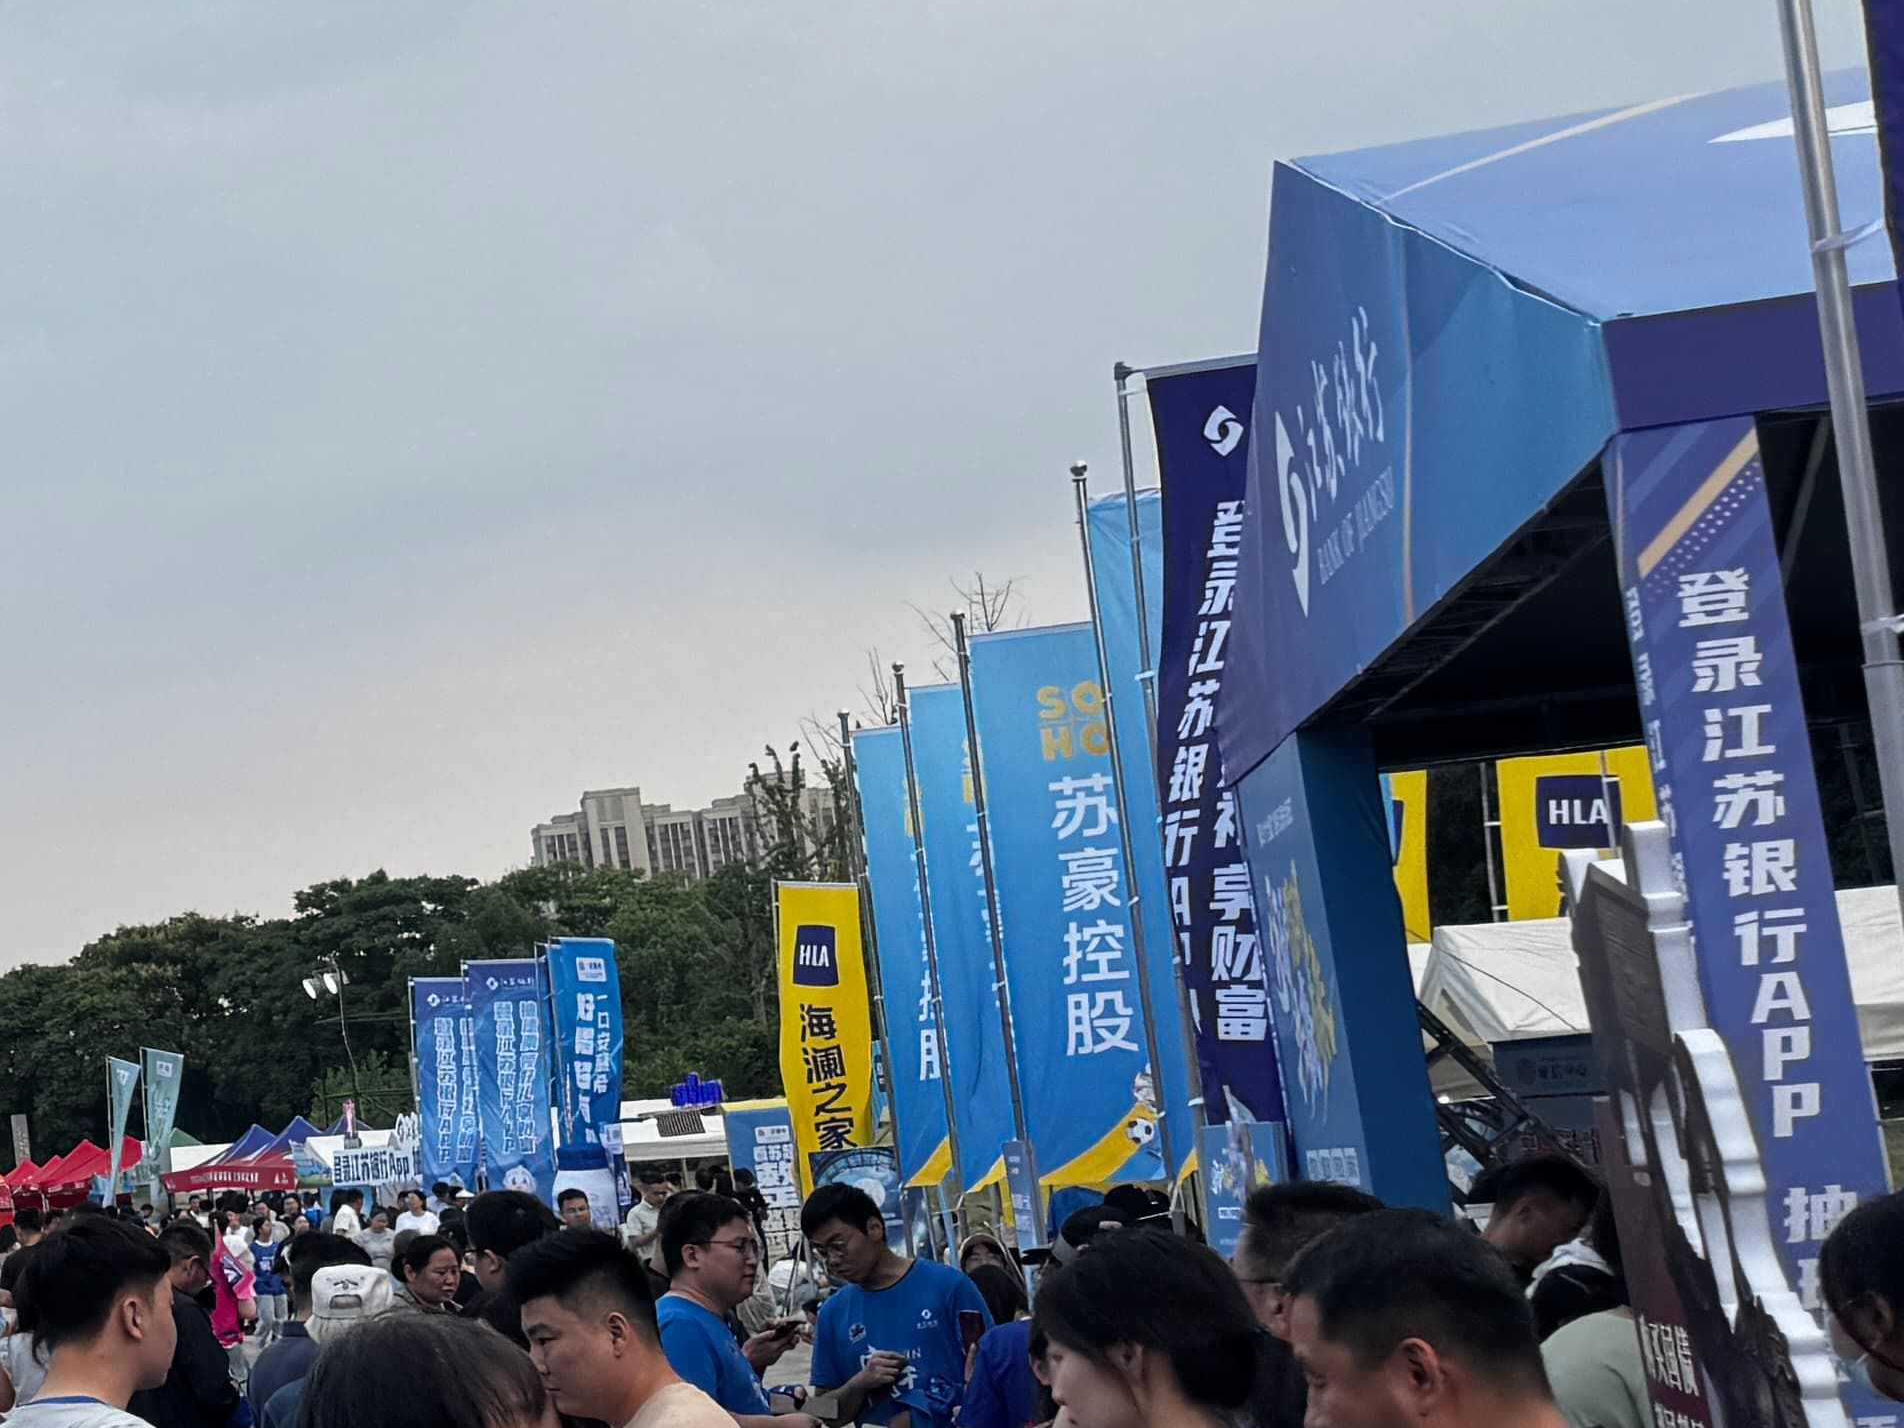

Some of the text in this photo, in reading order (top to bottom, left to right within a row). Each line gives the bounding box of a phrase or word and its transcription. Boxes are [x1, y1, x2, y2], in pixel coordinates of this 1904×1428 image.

[1548, 798, 1609, 826] HLA
[1678, 567, 1820, 1138] 登录江苏银行APP
[799, 944, 830, 967] HLA
[1049, 772, 1140, 1057] 苏豪控股
[1209, 863, 1267, 1042] 享财富
[799, 1003, 858, 1150] 海澜之家
